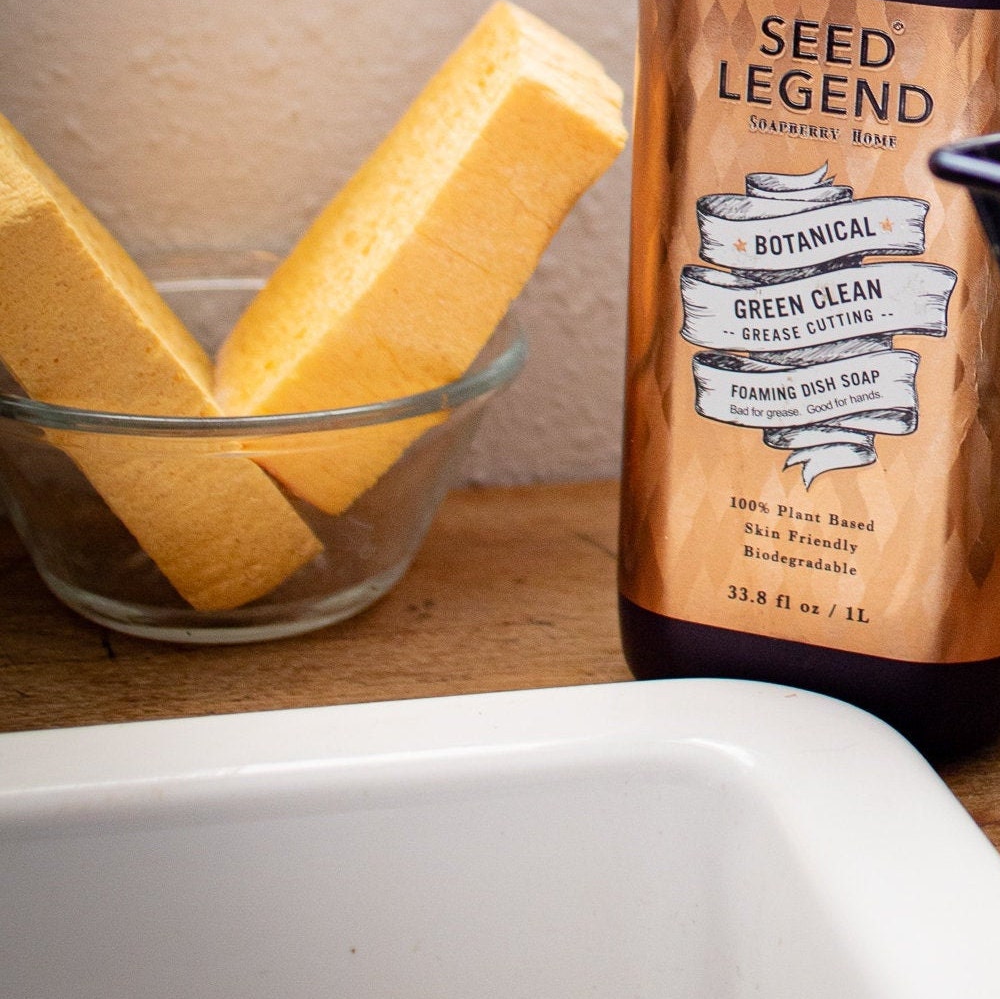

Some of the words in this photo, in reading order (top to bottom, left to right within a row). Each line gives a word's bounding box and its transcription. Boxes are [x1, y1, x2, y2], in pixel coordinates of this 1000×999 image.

[718, 60, 934, 124] LEGEND
[755, 217, 877, 256] BOTANICAL
[734, 294, 804, 319] GREEN
[811, 279, 882, 310] CLEAN
[742, 326, 801, 342] GREASE
[806, 308, 874, 335] CUTTING
[731, 384, 797, 401] FOAMING
[801, 376, 836, 397] DISH
[840, 370, 880, 388] SOAP
[729, 404, 749, 416] Bad
[750, 406, 764, 417] for
[806, 401, 834, 415] Good
[834, 398, 849, 408] for
[849, 390, 884, 403] hands.
[730, 496, 770, 514] 100%
[777, 504, 821, 523] Plant
[828, 513, 875, 533] Based
[744, 522, 781, 540] Skin
[788, 529, 859, 555] Friendly
[743, 544, 857, 576] Biodegradable
[727, 584, 767, 605] 33.8
[775, 594, 791, 610] fl
[800, 602, 820, 615] oz
[845, 606, 870, 624] 1L
